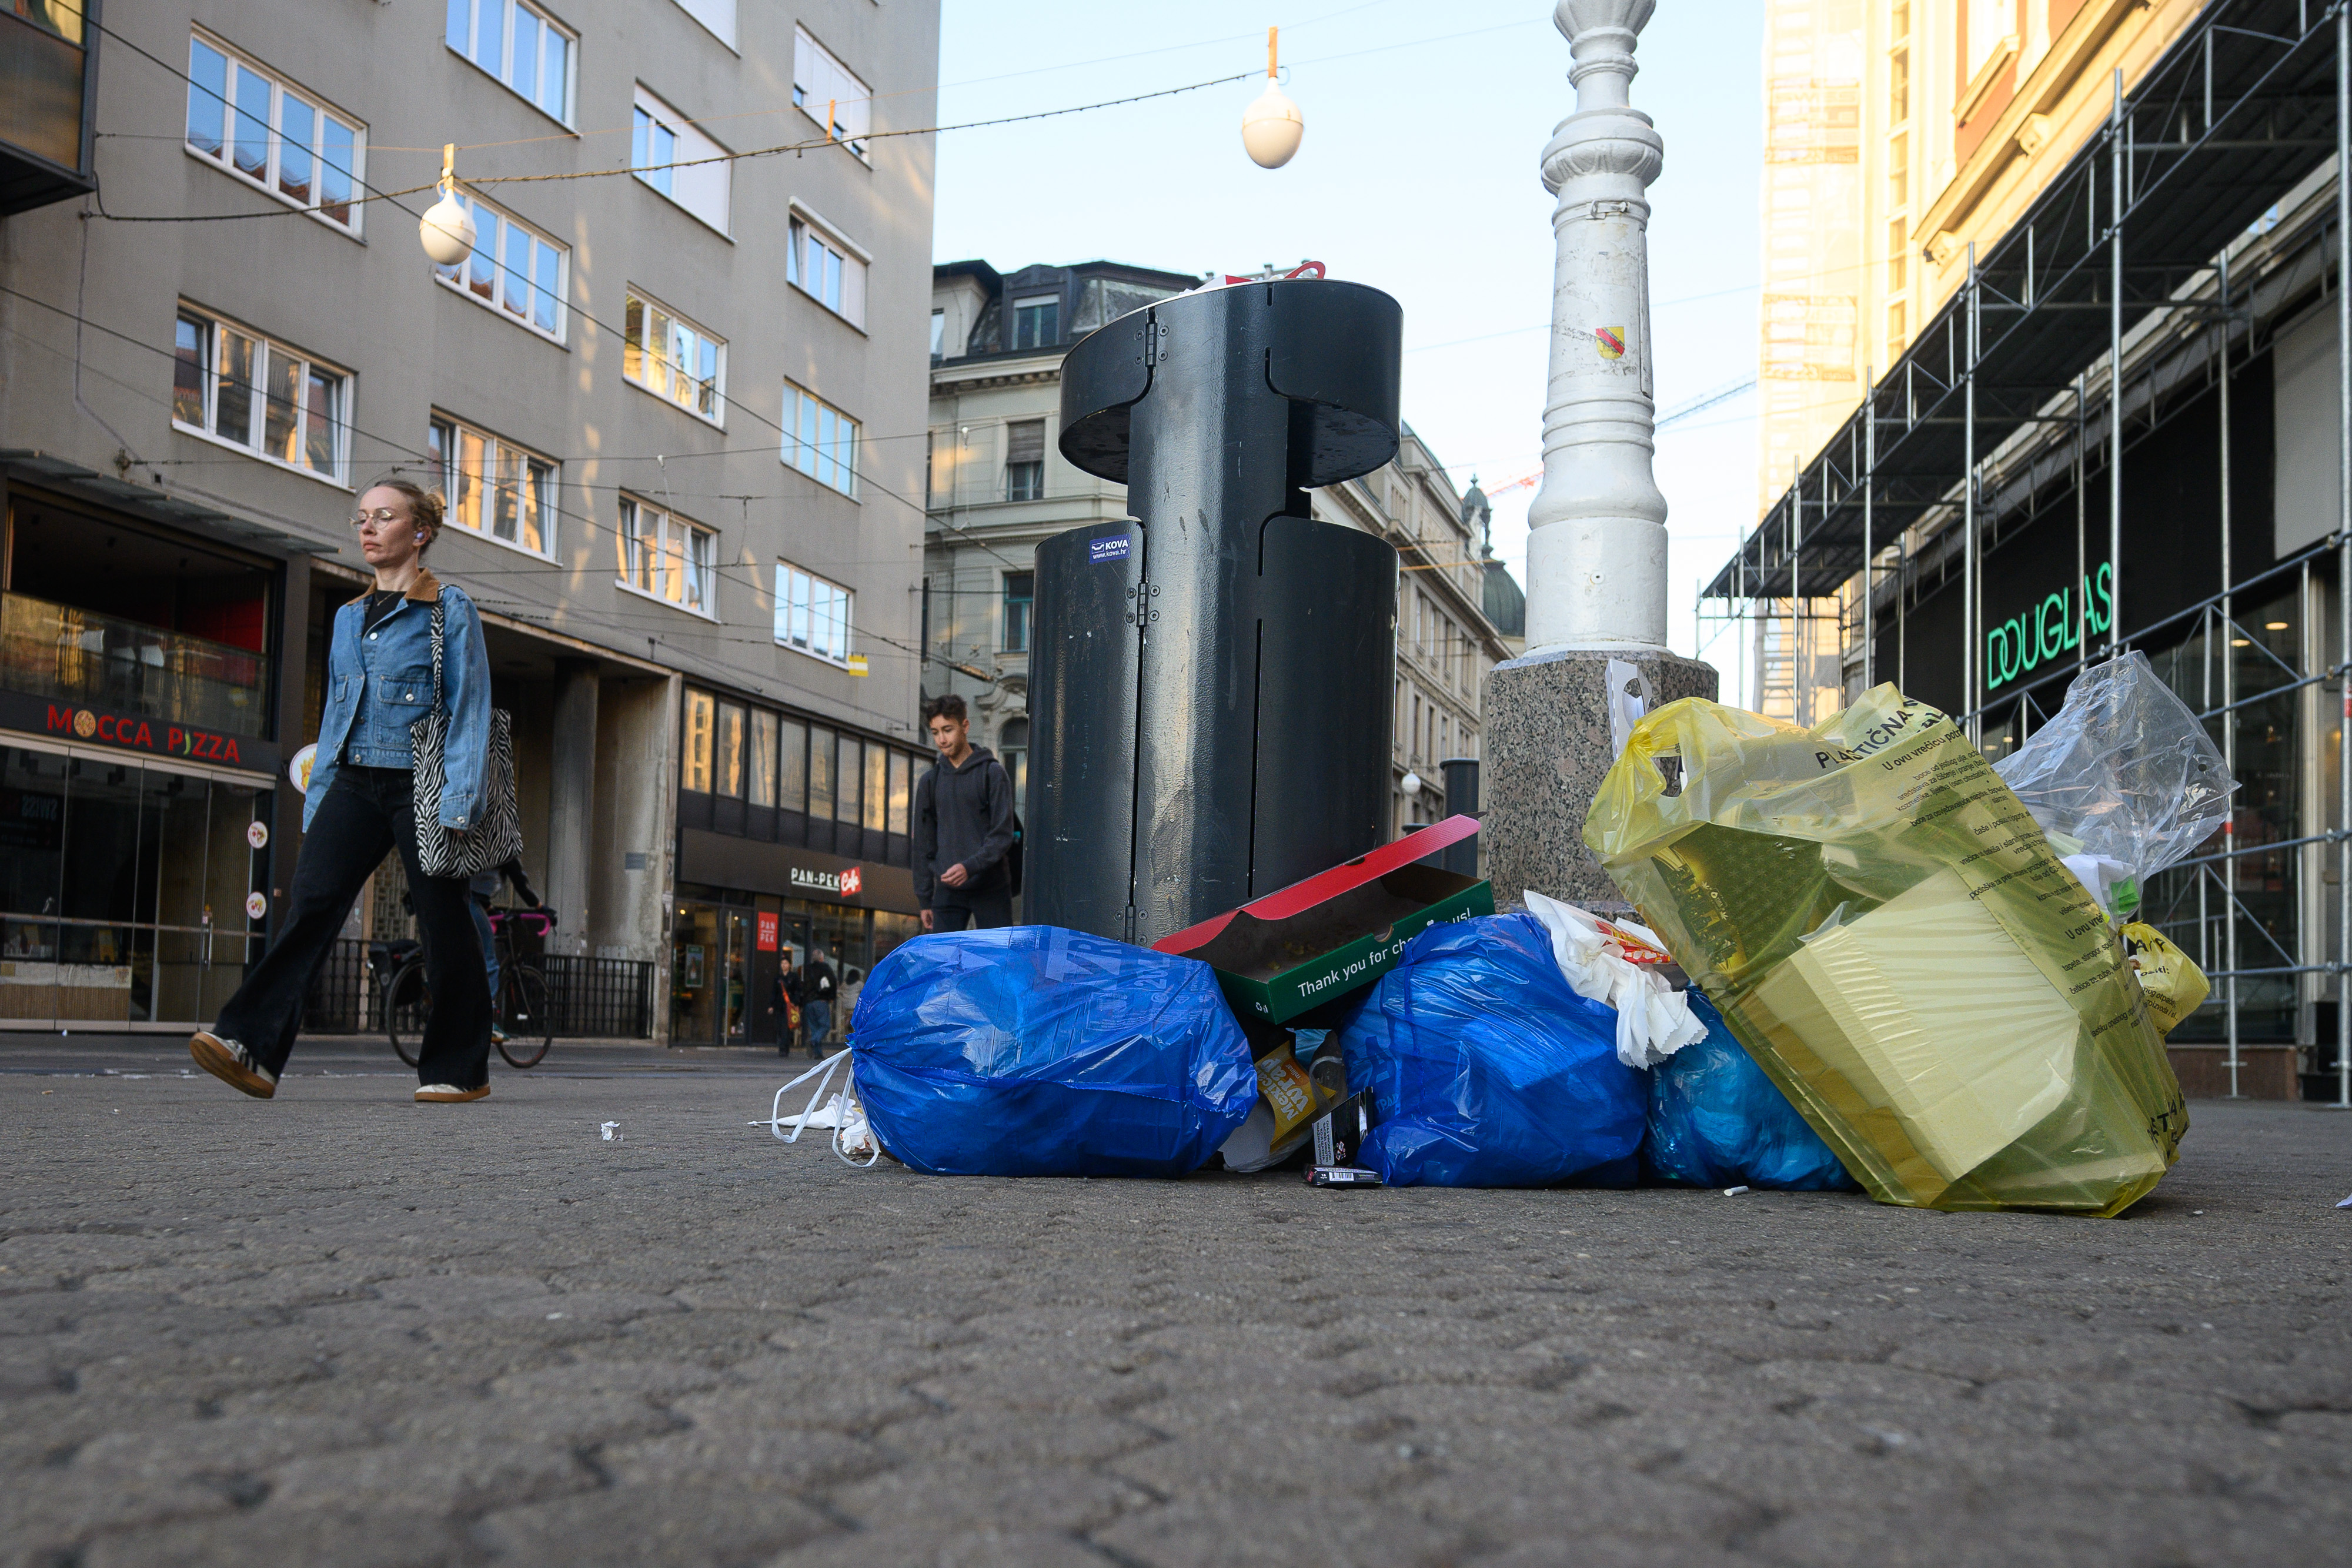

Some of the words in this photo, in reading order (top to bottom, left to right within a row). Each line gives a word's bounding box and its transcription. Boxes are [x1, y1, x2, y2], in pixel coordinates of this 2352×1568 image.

[1105, 539, 1128, 550] KOVA
[1093, 549, 1127, 559] www.kova.hr
[1987, 561, 2112, 690] DOUGLAS
[48, 704, 153, 748] MOCCA
[168, 727, 240, 763] PIZZA
[1815, 710, 1915, 769] PLASTIČNA
[1882, 761, 1894, 771] U
[1893, 753, 1912, 767] ovu
[1911, 736, 1946, 757] vrećicu
[1913, 768, 1931, 781] boce
[1931, 763, 1940, 772] od
[1897, 781, 1929, 800] sredstava
[1896, 790, 1932, 812] kozmetike,
[1910, 817, 1927, 828] boce
[1973, 824, 1990, 835] čaše
[791, 867, 840, 888] PAN-PEK
[2042, 870, 2050, 878] od
[760, 920, 776, 930] PAN
[2064, 929, 2076, 940] U
[2075, 922, 2092, 936] ovu
[760, 933, 775, 943] PEK
[1297, 971, 1340, 997] Thank
[1343, 959, 1367, 982] you
[1369, 947, 1388, 965] for
[2062, 958, 2084, 971] tapete,
[2097, 968, 2114, 981] zube,
[1285, 1064, 1302, 1080] mlinar
